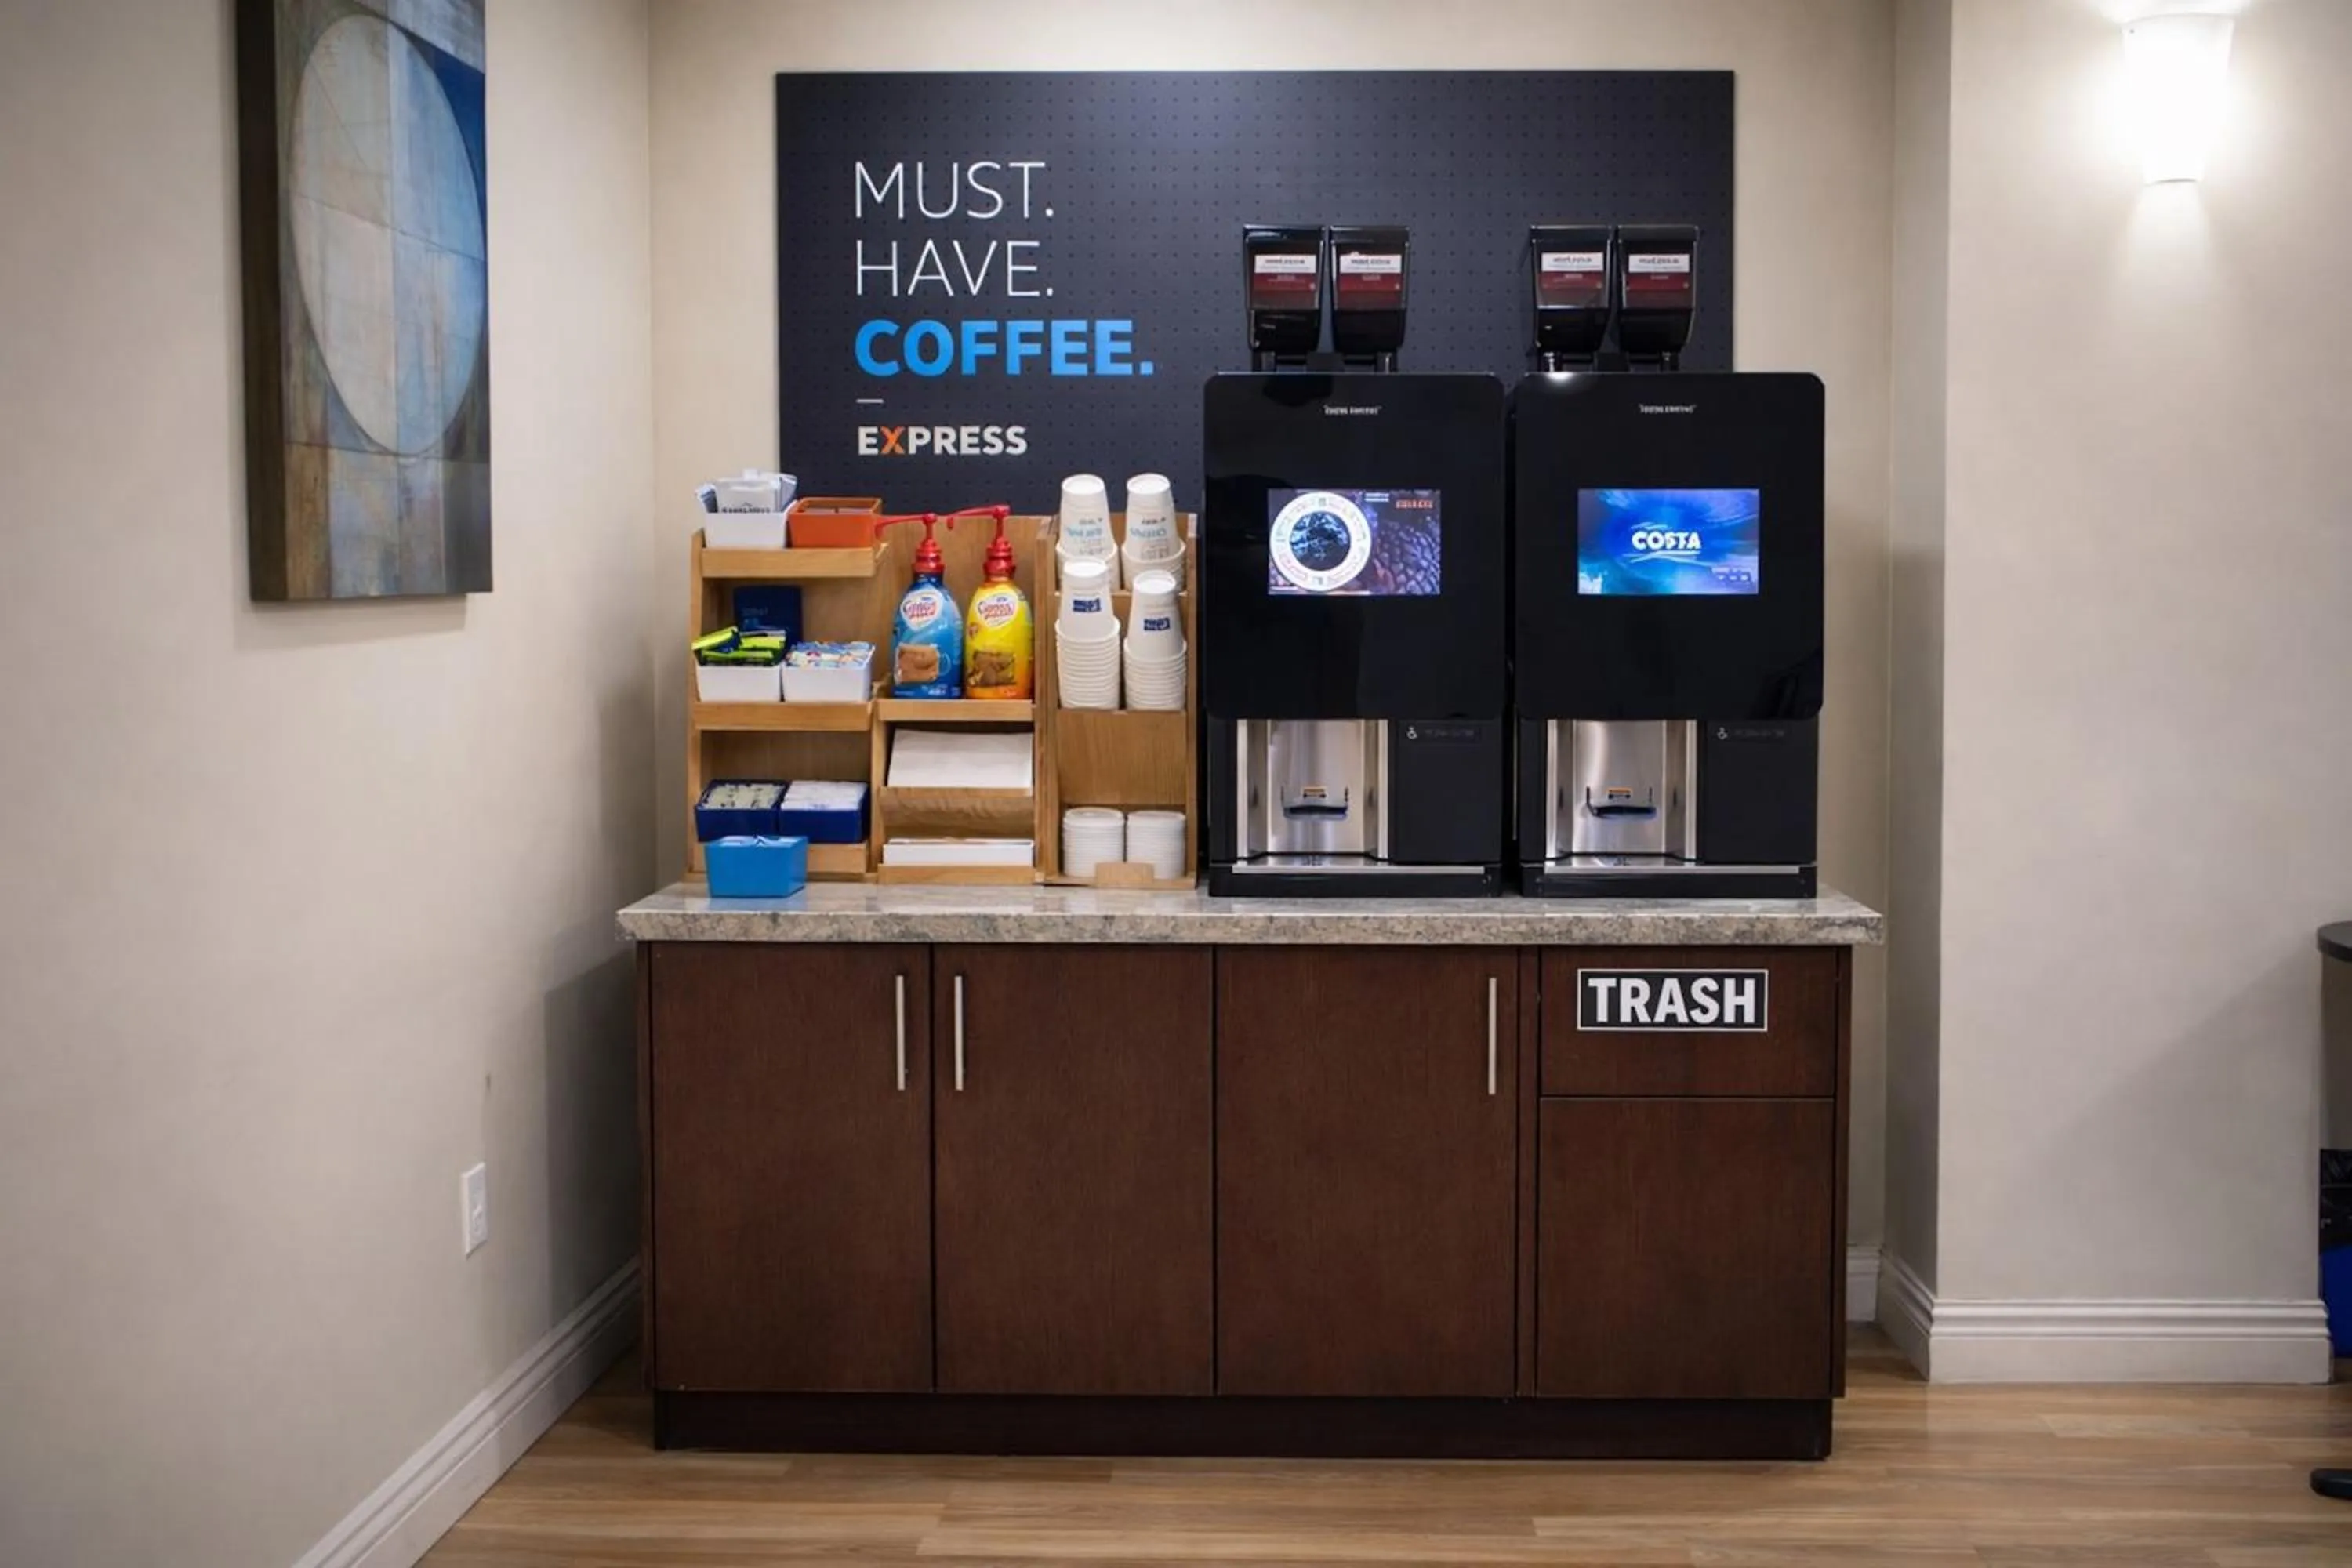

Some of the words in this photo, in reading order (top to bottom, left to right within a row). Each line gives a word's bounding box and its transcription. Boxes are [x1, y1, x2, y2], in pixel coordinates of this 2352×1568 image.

[855, 161, 1054, 219] MUST.
[857, 239, 1054, 297] HAVE.
[855, 319, 1154, 376] COFFEE.
[858, 426, 1028, 456] EXPRESS
[1632, 531, 1702, 550] COSTA
[1588, 978, 1756, 1024] TRASH
